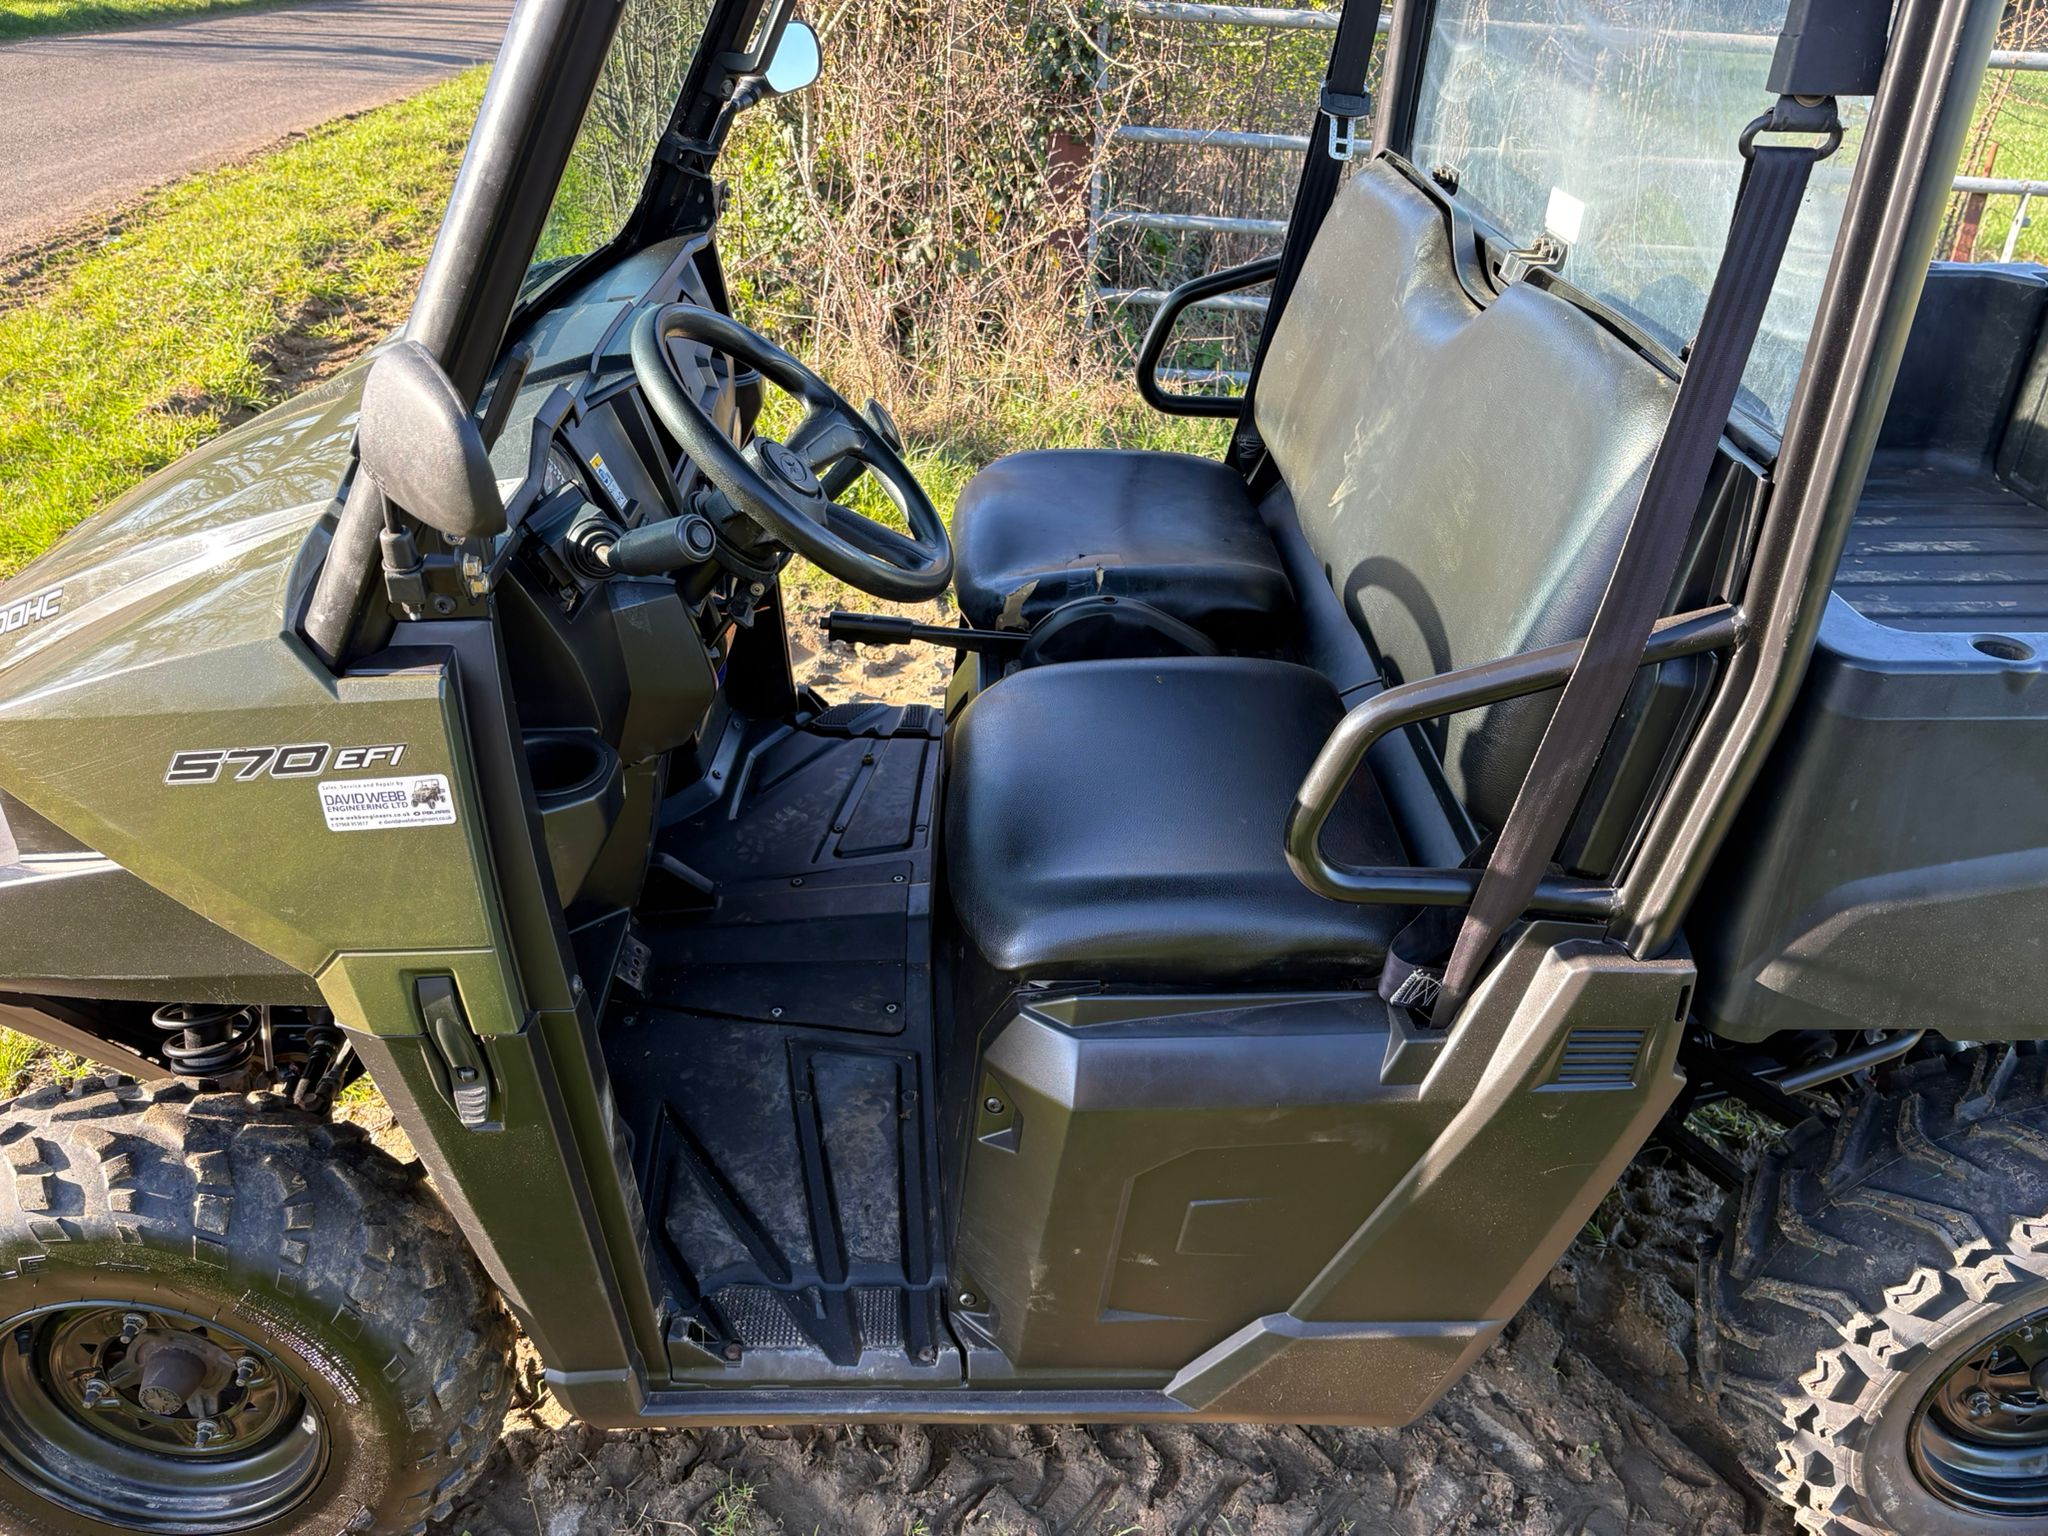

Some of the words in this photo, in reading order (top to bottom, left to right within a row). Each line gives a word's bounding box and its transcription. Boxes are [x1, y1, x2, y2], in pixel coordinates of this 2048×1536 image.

[164, 742, 331, 785] 570
[333, 742, 408, 770] EFI
[324, 792, 365, 806] DAVID
[365, 790, 407, 804] WEBB
[326, 802, 390, 813] ENGINEERING
[391, 801, 409, 809] LTD
